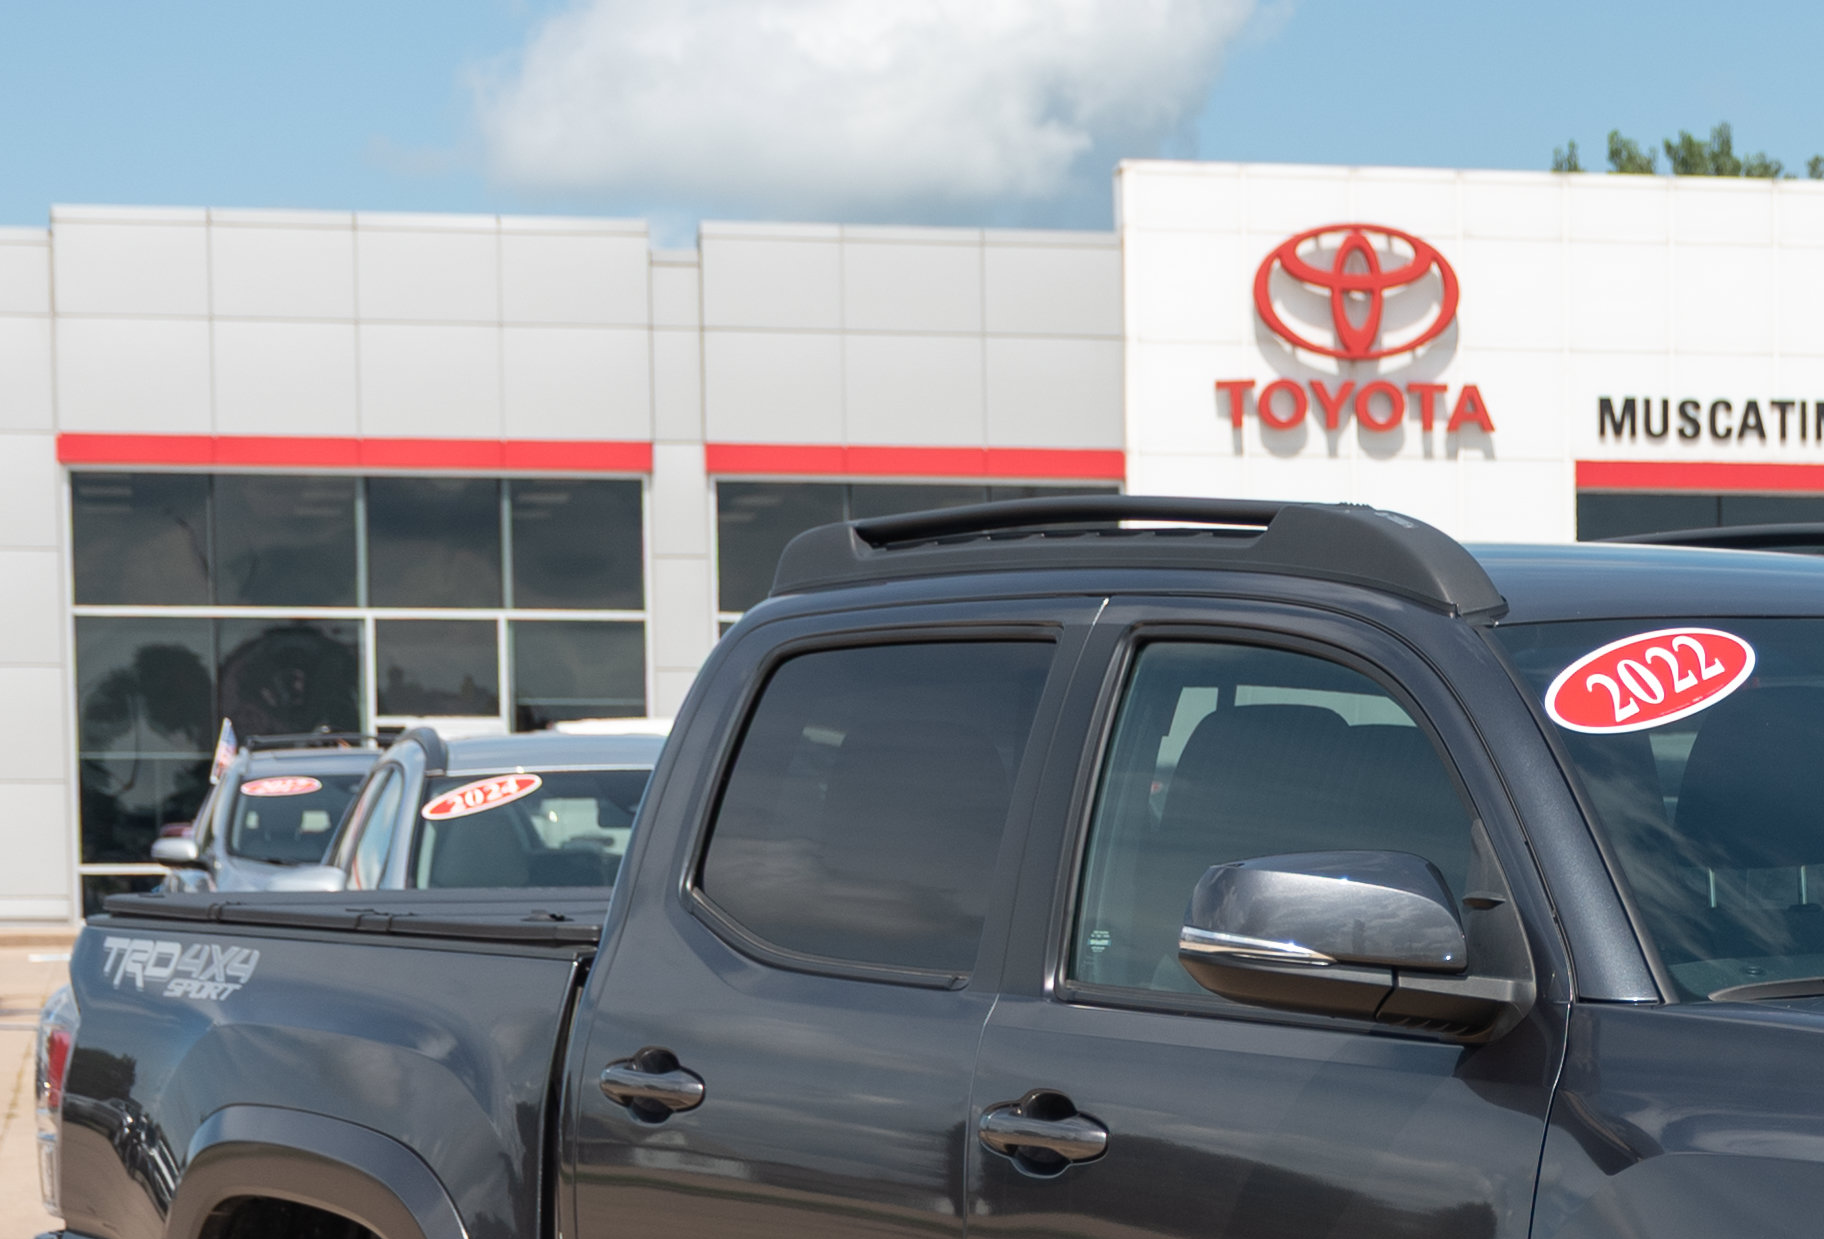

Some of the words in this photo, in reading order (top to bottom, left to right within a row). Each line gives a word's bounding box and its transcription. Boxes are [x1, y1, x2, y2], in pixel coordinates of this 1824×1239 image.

[1216, 378, 1496, 434] TOYOTA
[1585, 635, 1726, 723] 2022
[449, 776, 520, 815] 2024
[163, 979, 243, 1001] SPORT
